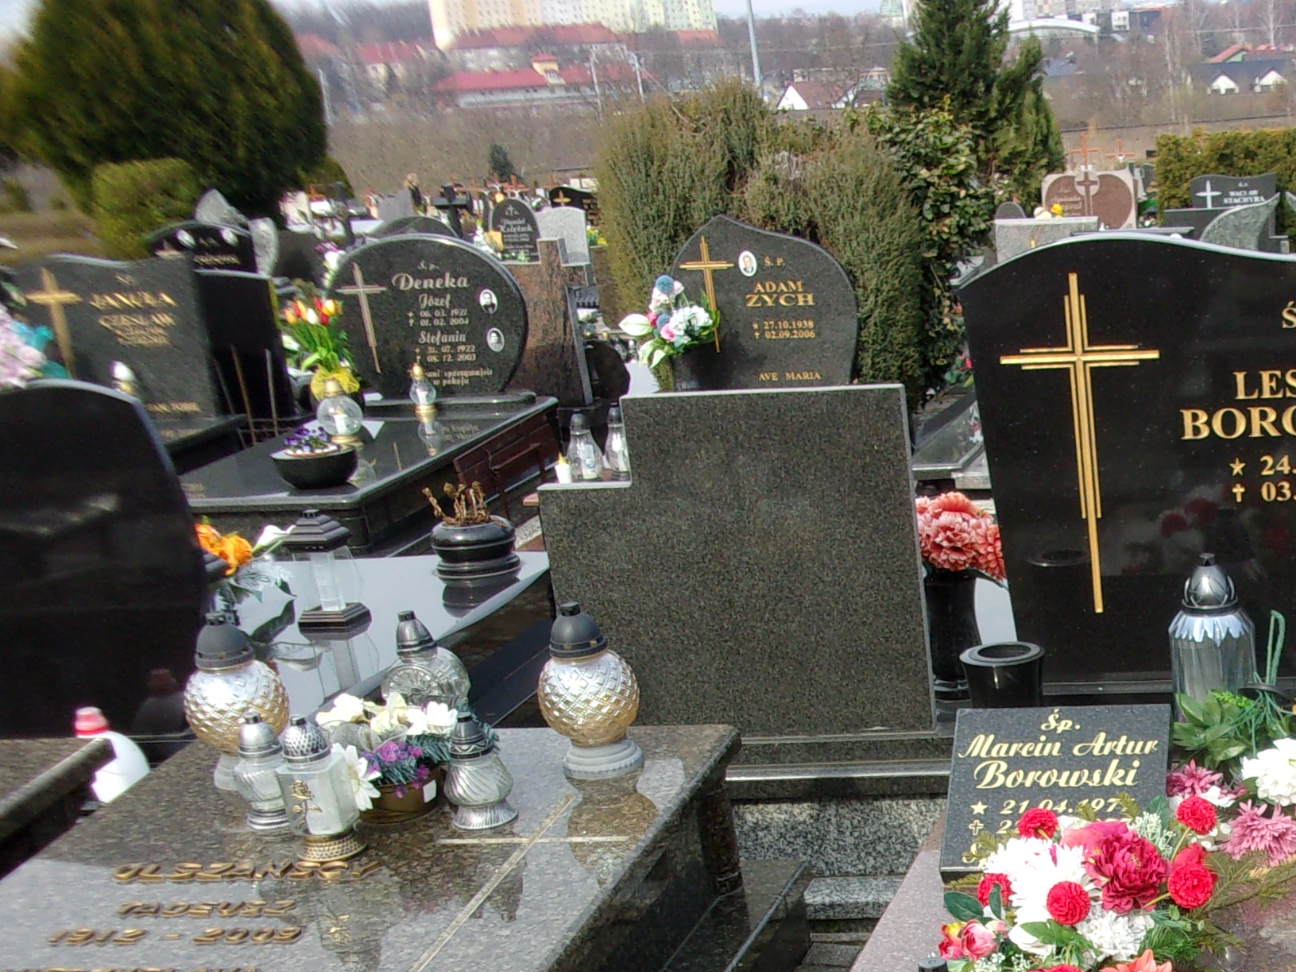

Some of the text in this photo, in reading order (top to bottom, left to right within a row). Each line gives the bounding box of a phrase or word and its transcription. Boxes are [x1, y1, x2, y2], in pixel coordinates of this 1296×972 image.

[391, 272, 470, 291] Deneka
[754, 281, 804, 293] ADAM
[746, 293, 816, 307] ZYCH
[958, 732, 1158, 759] Marcin Artur
[973, 758, 1141, 790] Borowski
[118, 900, 297, 918] TADEUSZ
